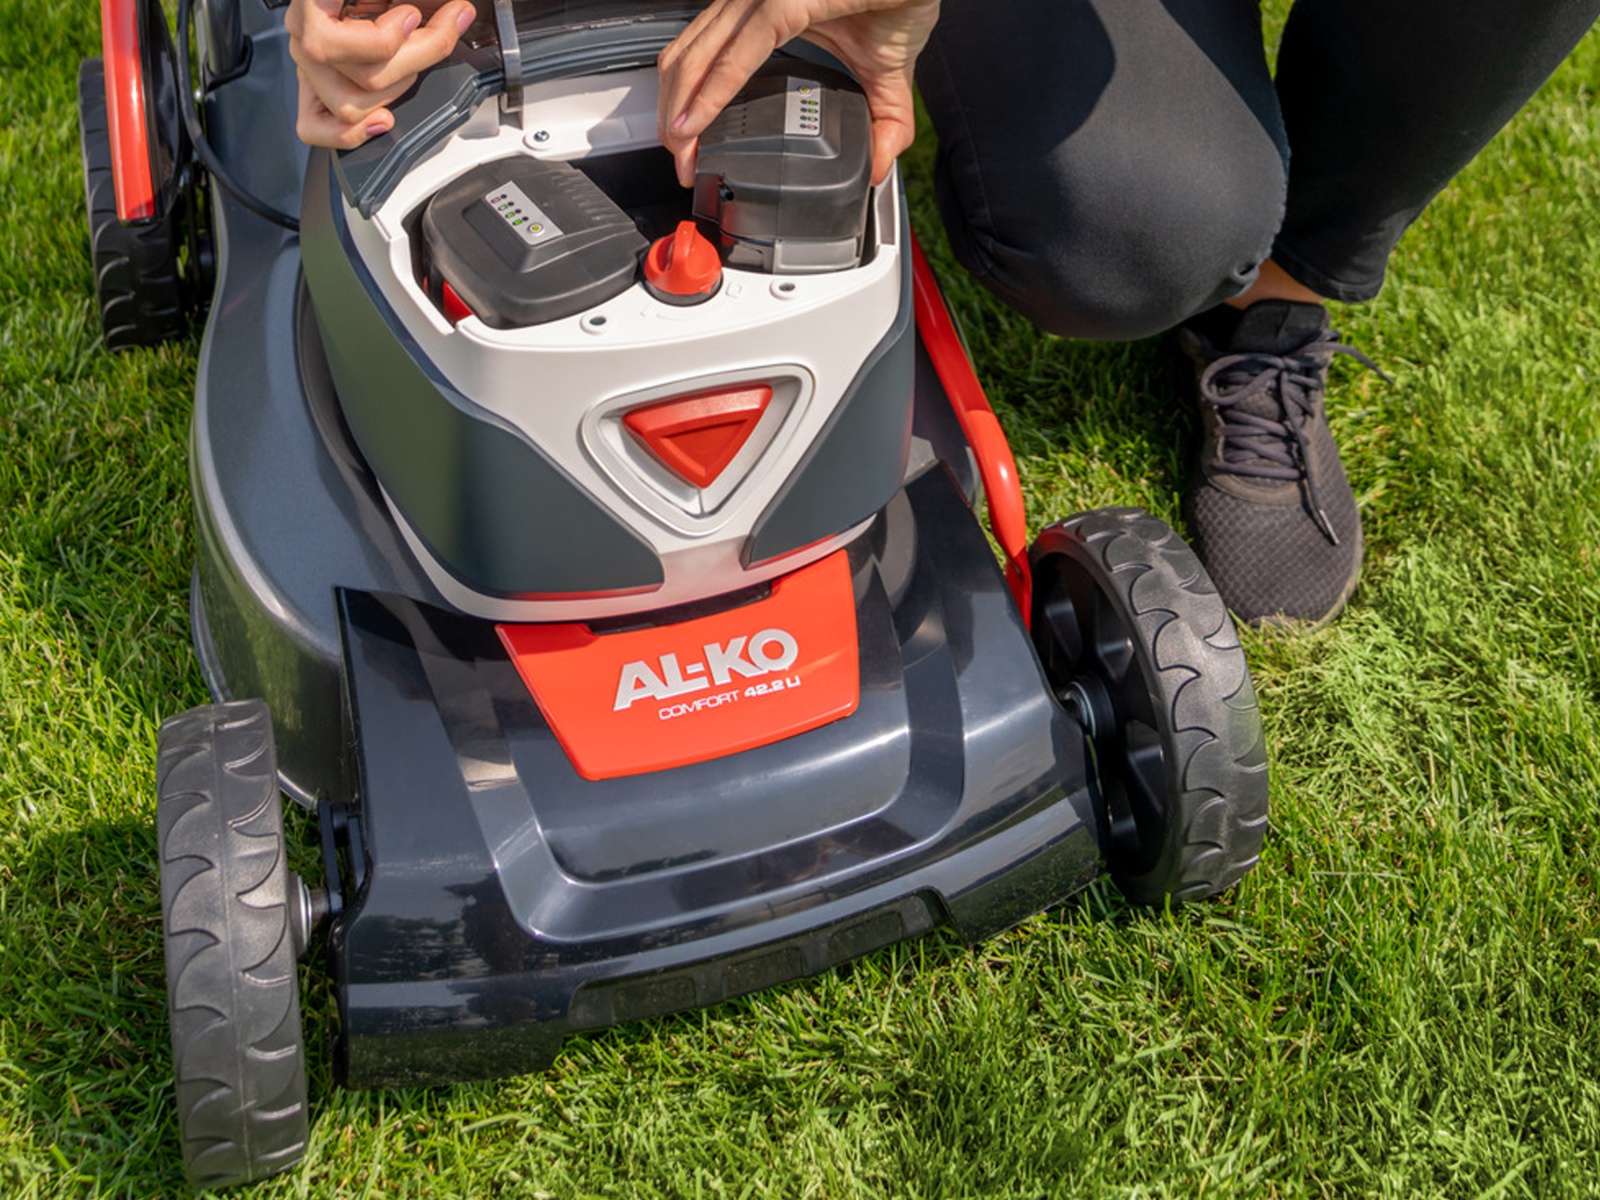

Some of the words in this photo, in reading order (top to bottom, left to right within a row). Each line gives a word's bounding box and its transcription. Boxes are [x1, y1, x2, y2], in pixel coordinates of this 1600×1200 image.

[613, 628, 799, 712] AL-KO
[658, 690, 739, 720] COMFORT
[744, 680, 785, 698] 42.2
